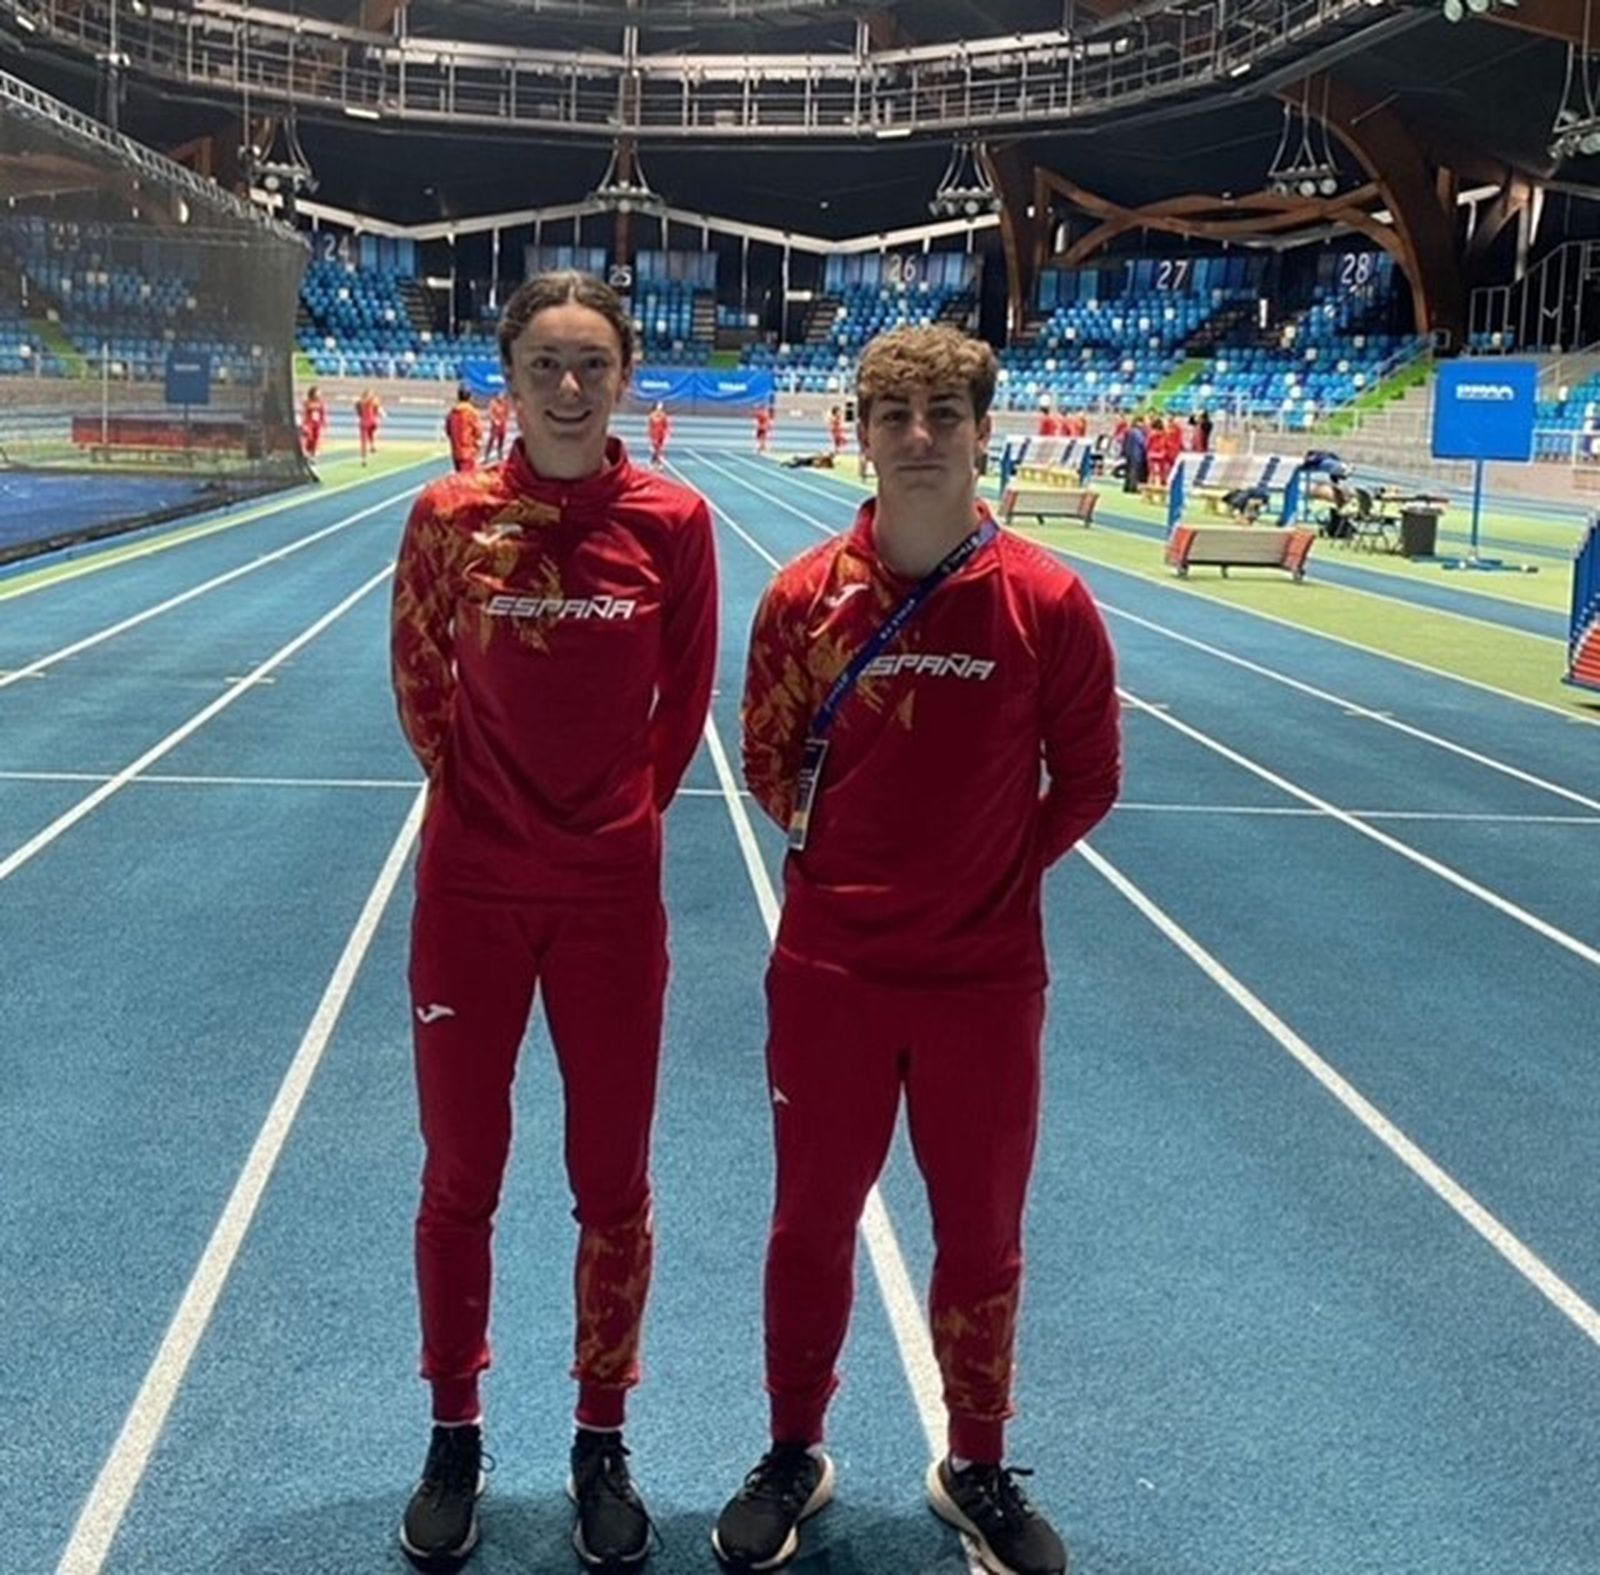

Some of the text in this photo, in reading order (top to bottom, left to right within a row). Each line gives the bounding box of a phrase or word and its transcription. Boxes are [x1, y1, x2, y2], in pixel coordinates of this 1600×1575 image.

[323, 233, 349, 261] 24
[609, 264, 632, 287] 25
[888, 254, 916, 281] 26
[1157, 260, 1188, 290] 27
[1341, 252, 1369, 284] 28
[486, 595, 636, 619] ESPAÑA
